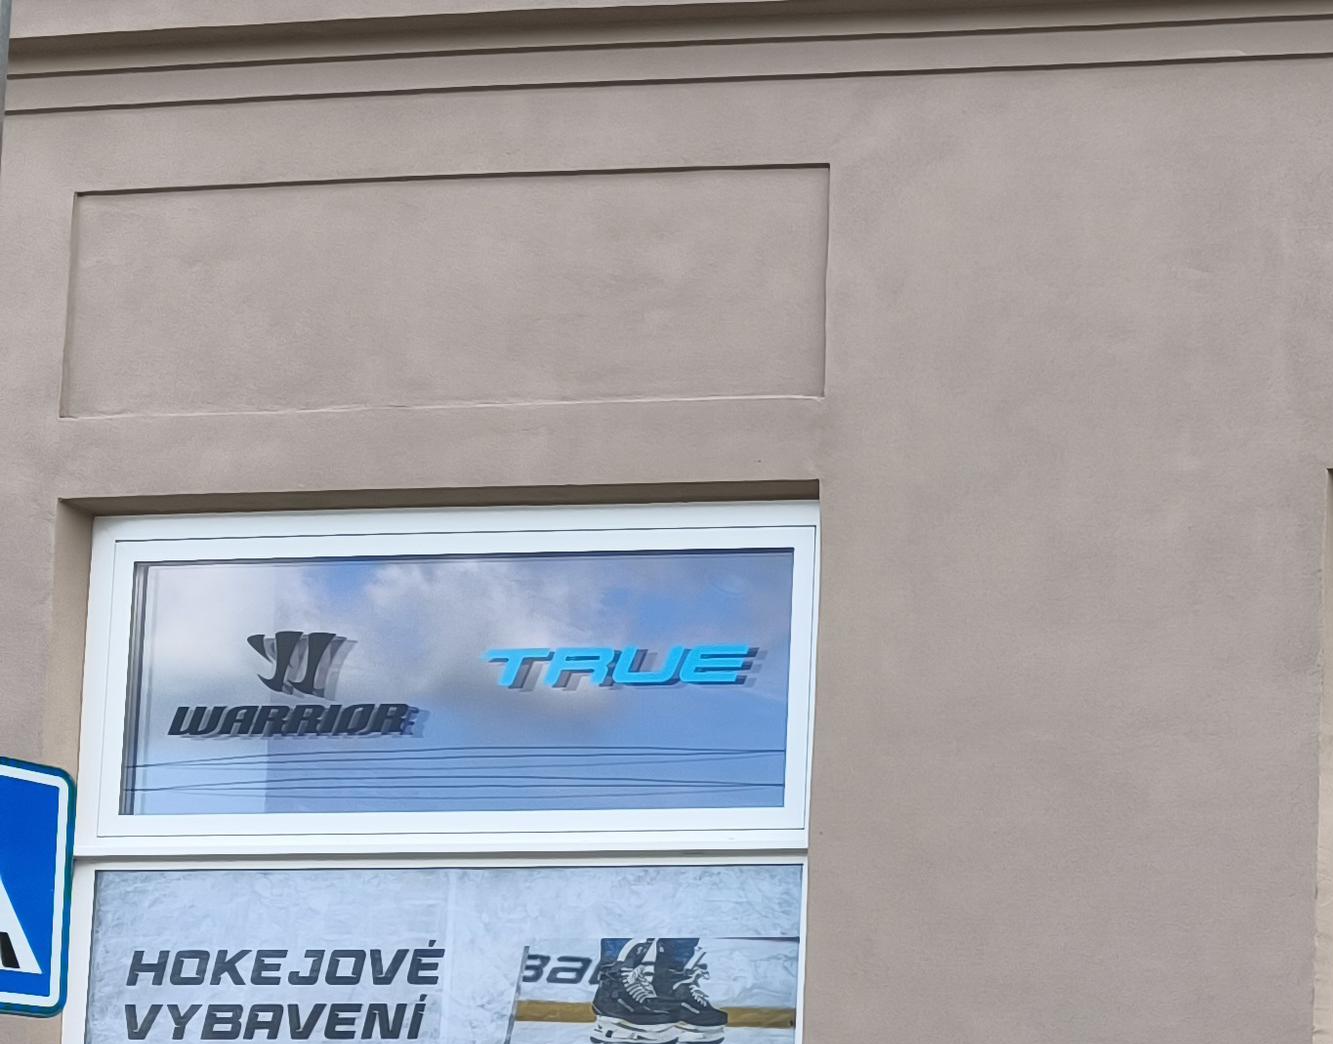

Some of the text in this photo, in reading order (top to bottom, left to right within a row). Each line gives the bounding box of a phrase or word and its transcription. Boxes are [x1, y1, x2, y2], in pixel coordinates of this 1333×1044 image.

[481, 643, 750, 687] TRUE
[167, 702, 412, 737] WARRIOR
[125, 939, 446, 987] HOKEJOVÉ
[124, 993, 426, 1041] VYBAVENÍ
